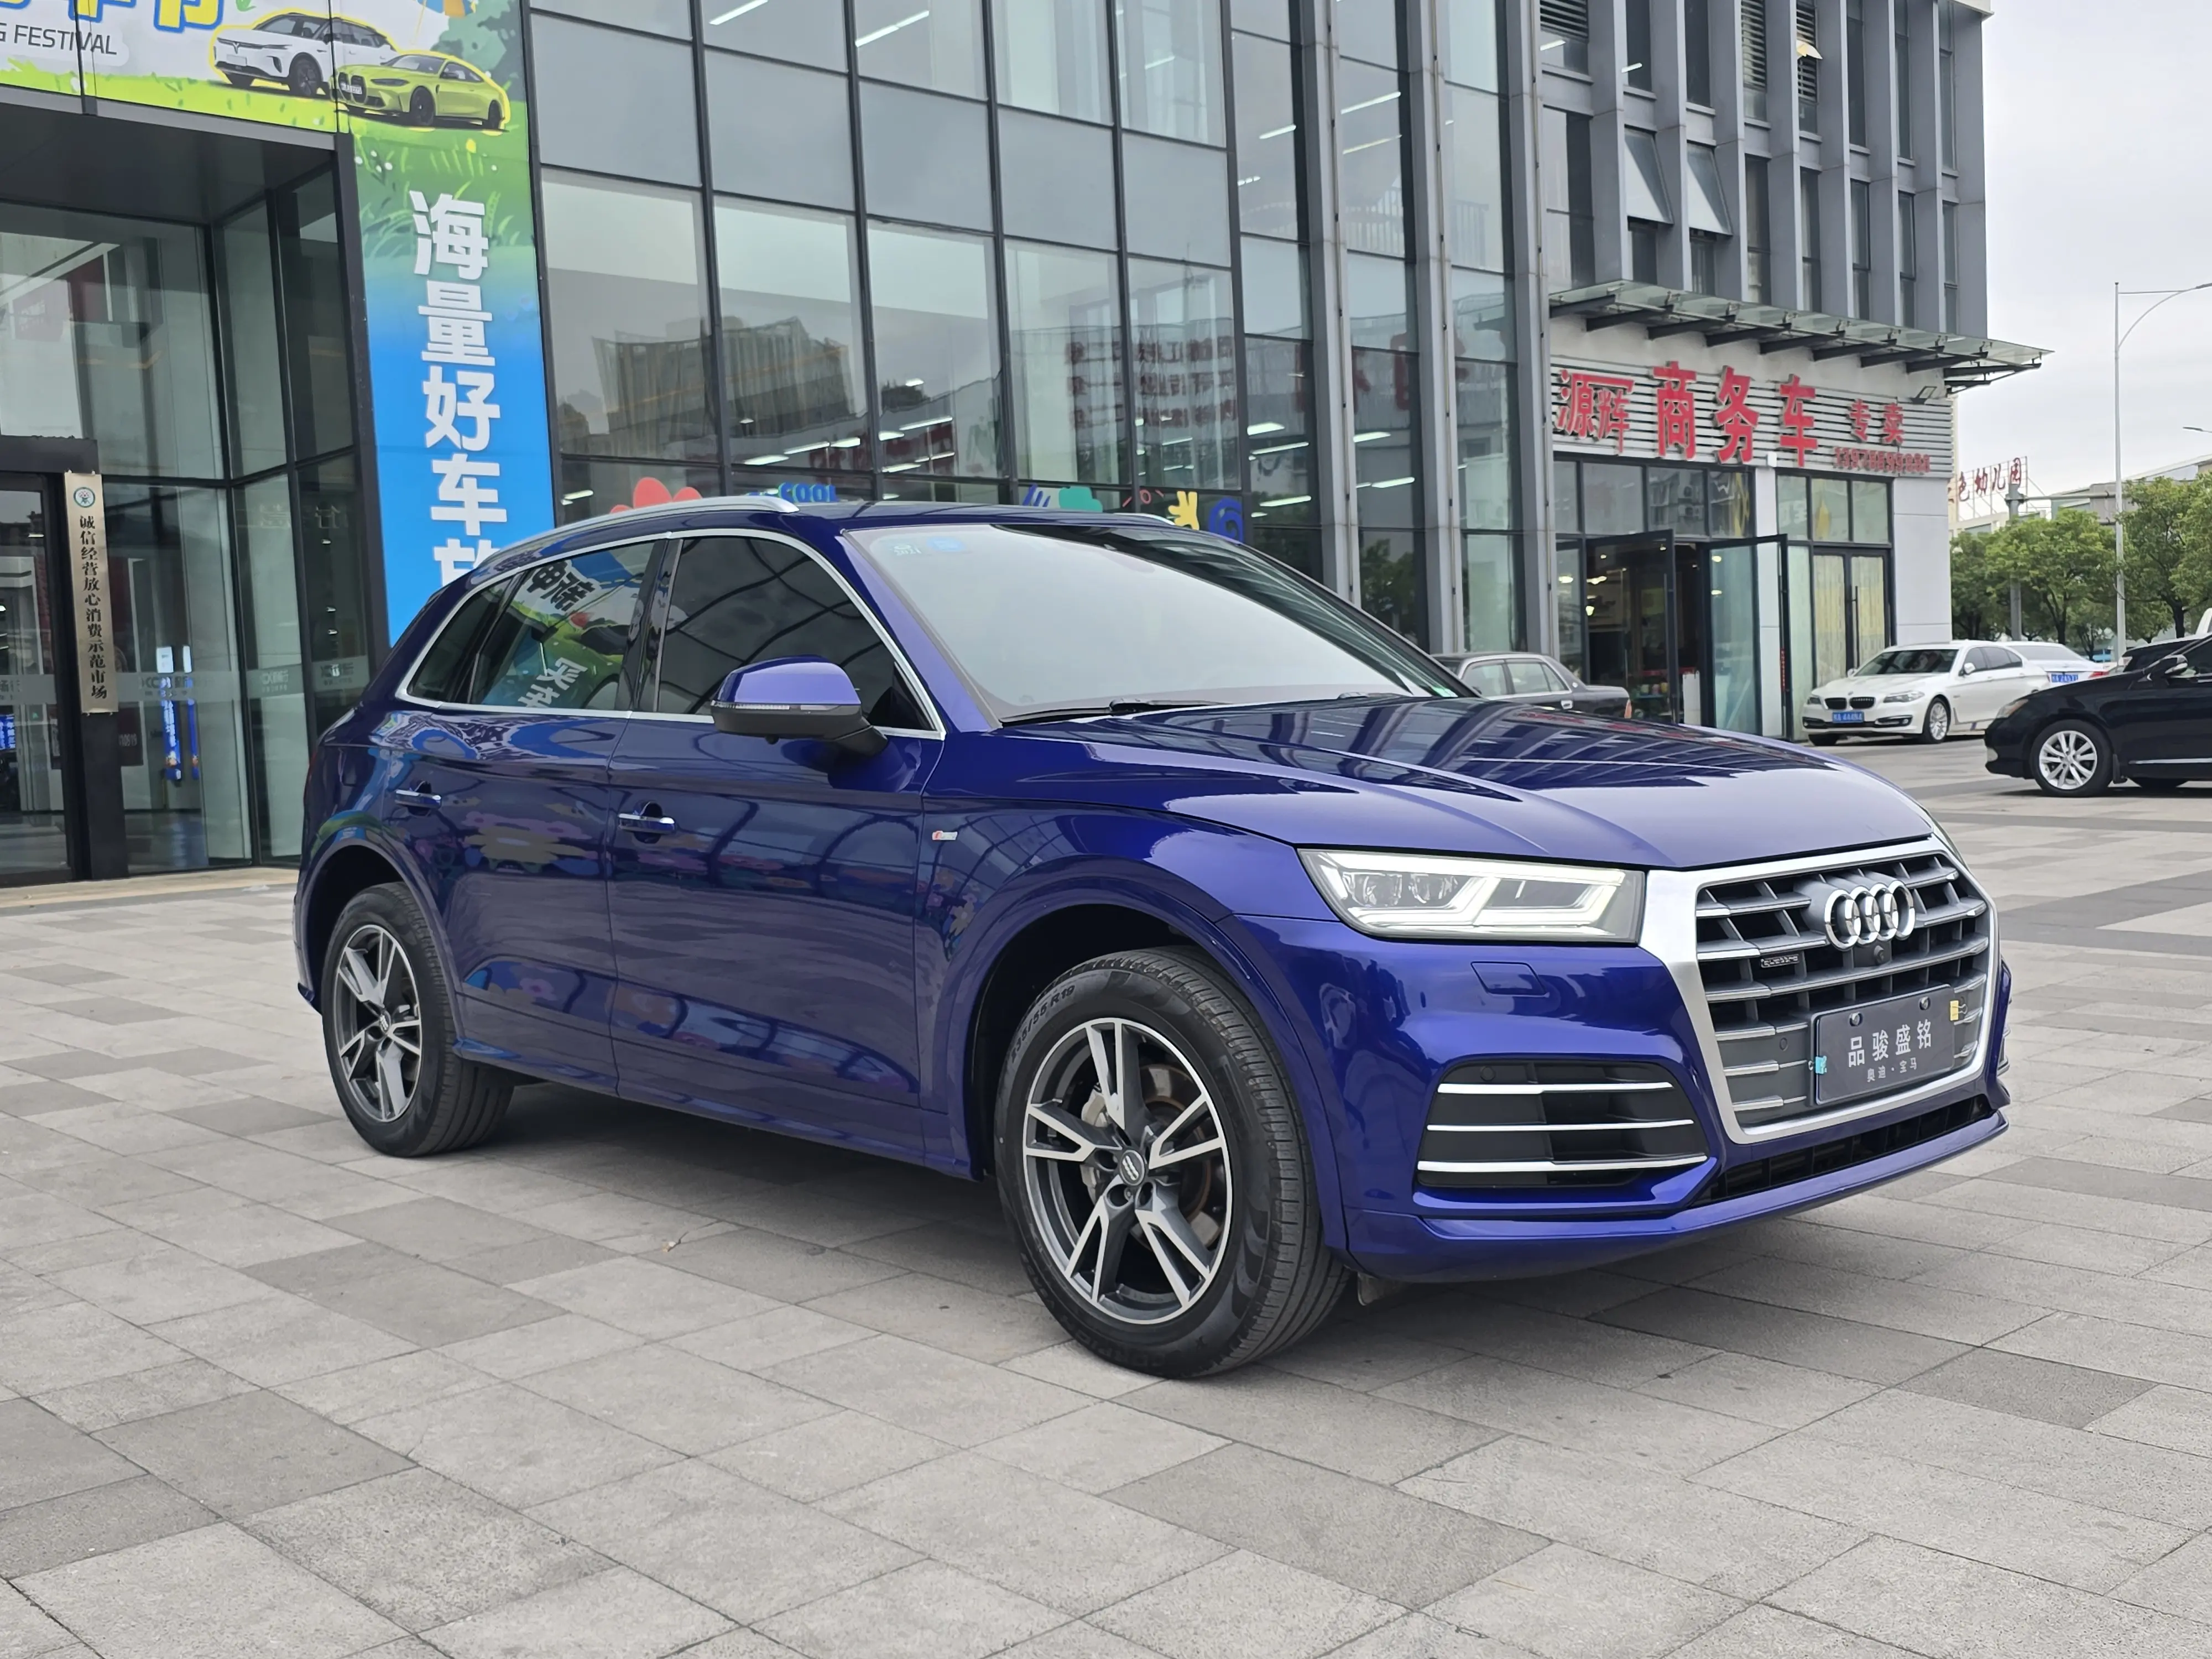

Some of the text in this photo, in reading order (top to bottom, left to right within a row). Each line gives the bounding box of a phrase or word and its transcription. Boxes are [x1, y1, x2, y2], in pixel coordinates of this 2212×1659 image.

[14, 24, 117, 55] FESTIVAL
[1557, 361, 1905, 468] 源辉 商务车 专卖
[79, 515, 107, 700] 诚信经营放心消费示范市场
[1050, 985, 1076, 1007] R19
[1848, 1018, 1932, 1068] 品骏盛铭
